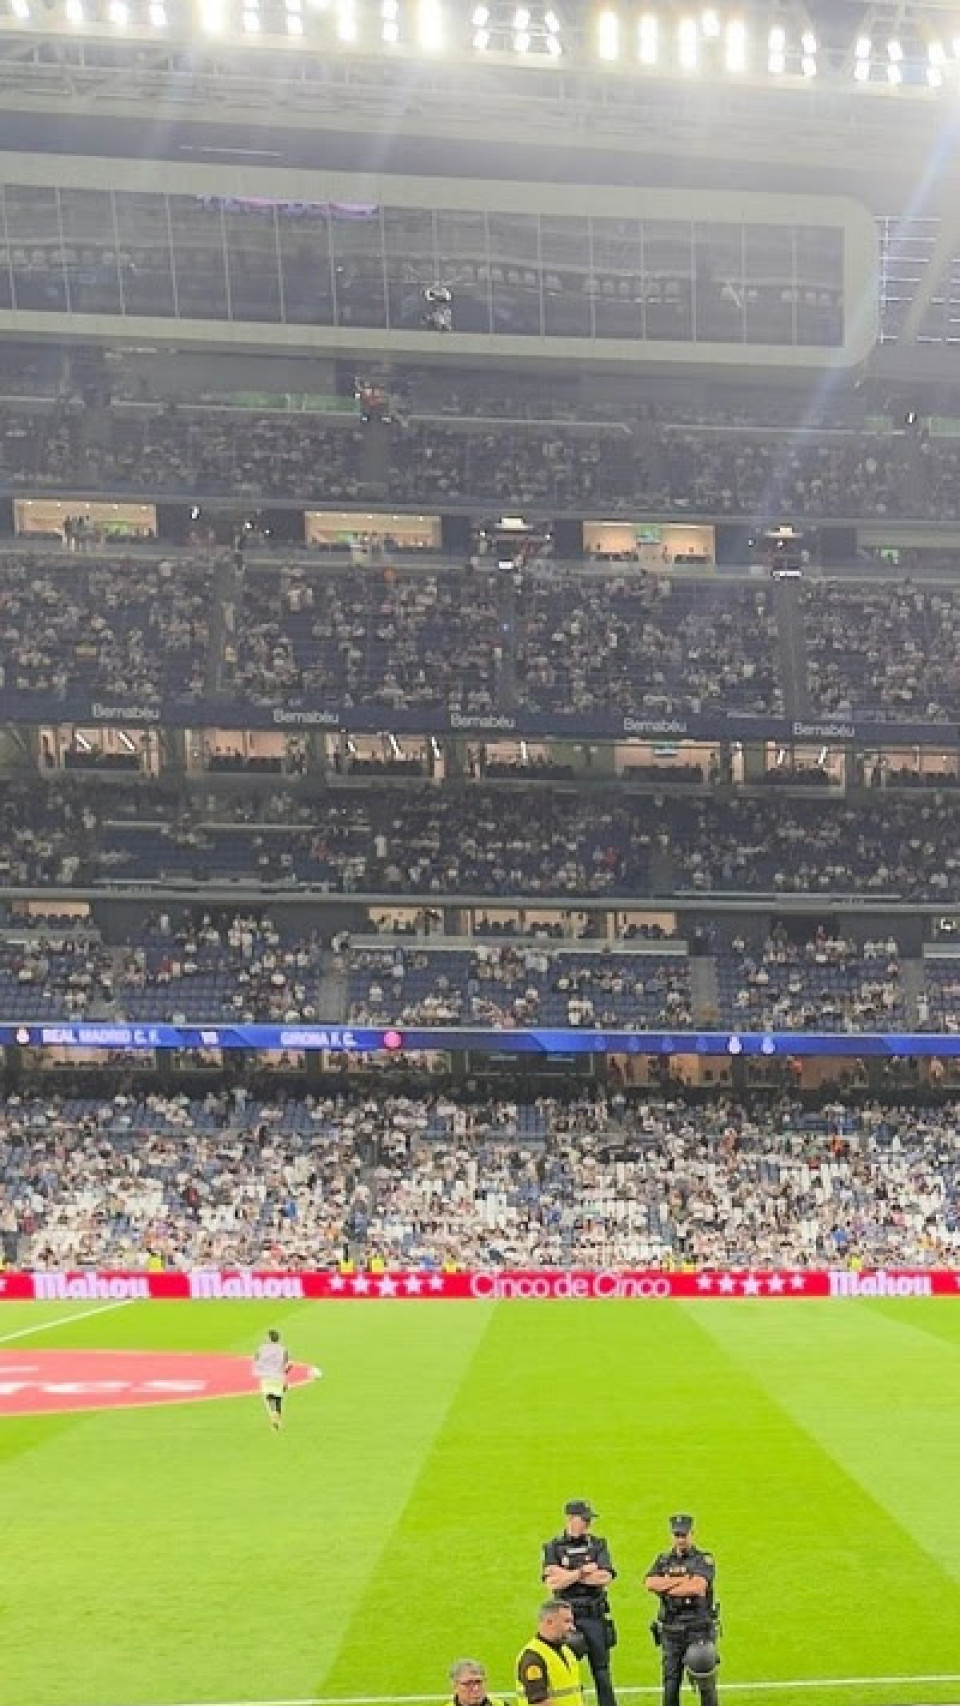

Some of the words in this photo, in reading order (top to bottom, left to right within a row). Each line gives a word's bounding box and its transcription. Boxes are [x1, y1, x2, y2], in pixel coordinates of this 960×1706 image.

[34, 1271, 149, 1298] Mahou
[190, 1271, 302, 1298] Mahou
[471, 1272, 549, 1297] Cinco
[554, 1272, 589, 1297] de
[594, 1273, 671, 1297] Cinco
[828, 1271, 932, 1296] Mahou
